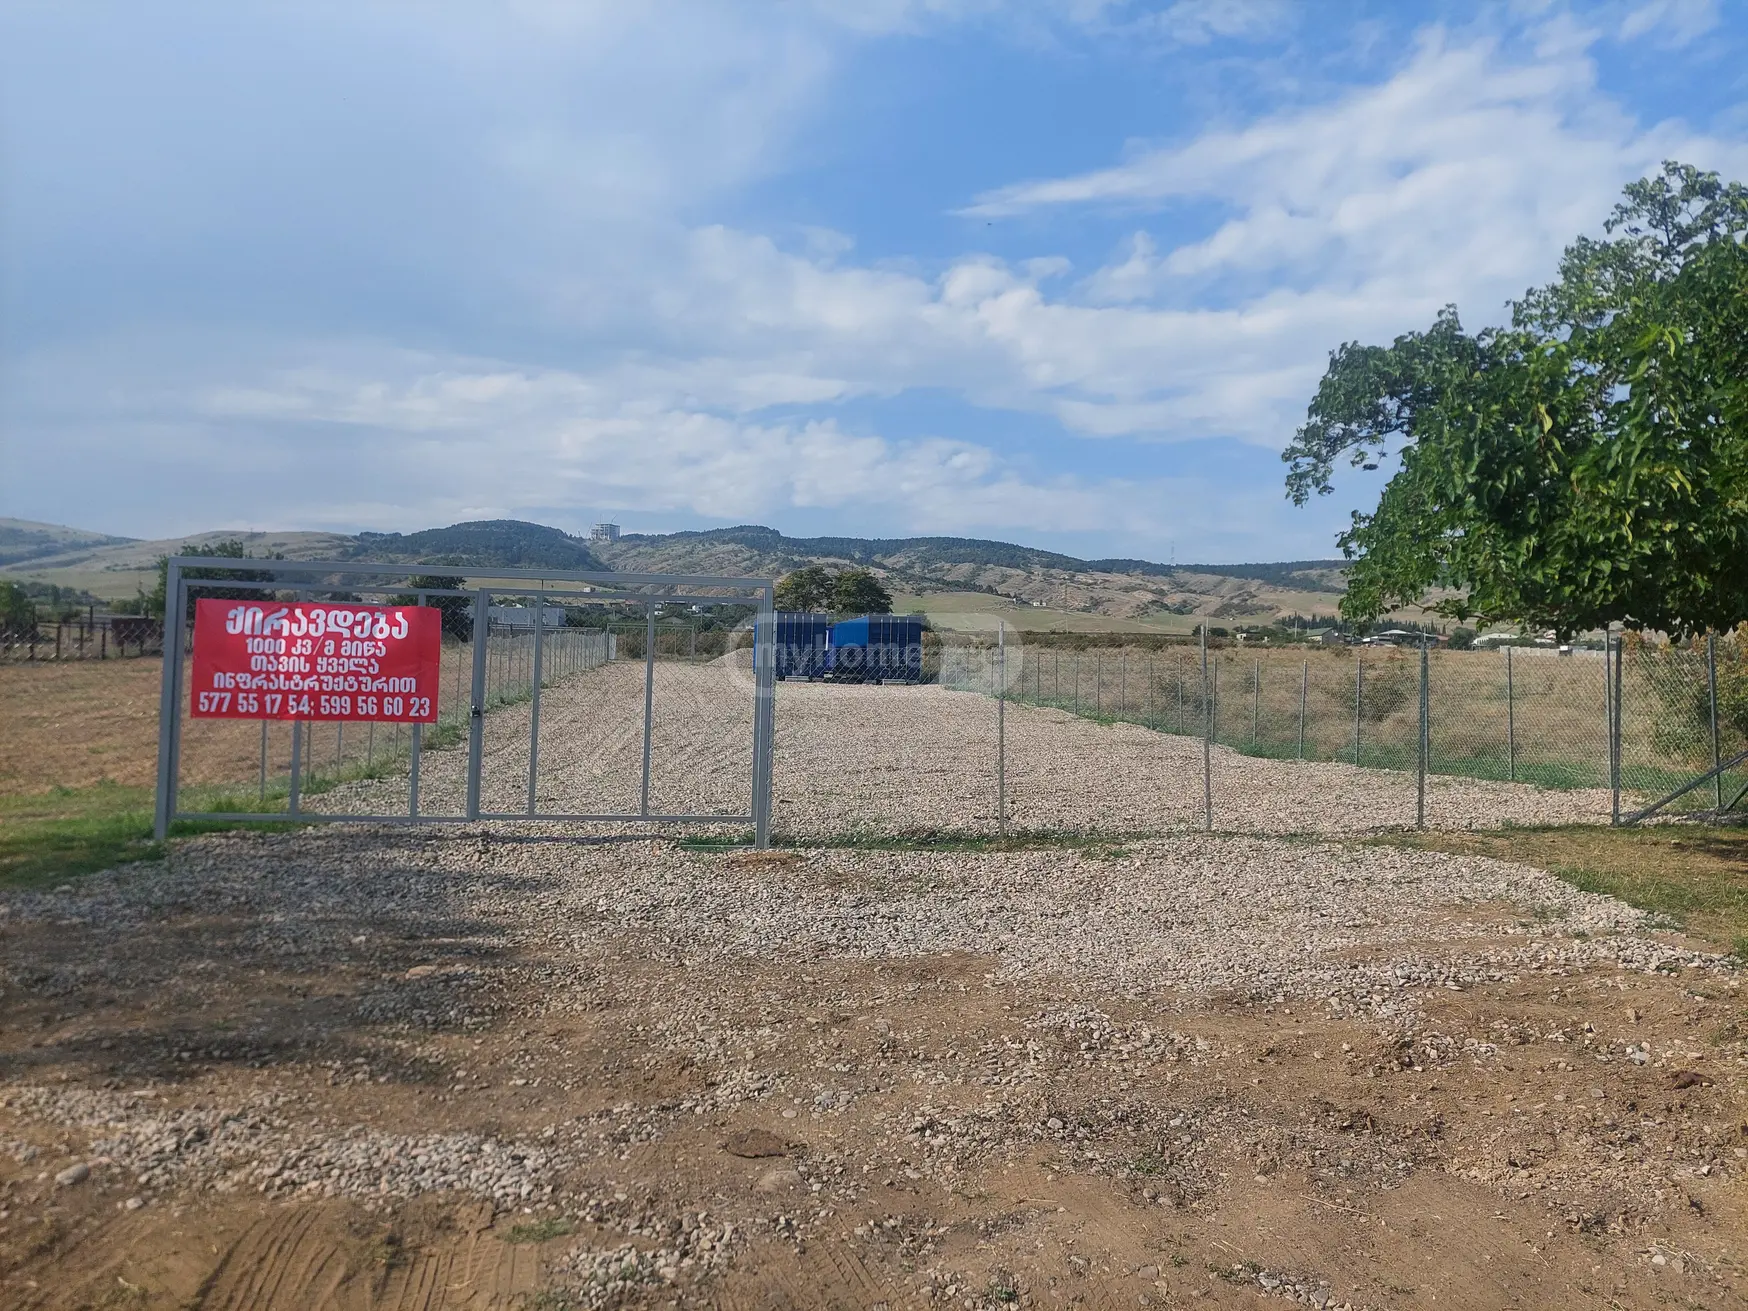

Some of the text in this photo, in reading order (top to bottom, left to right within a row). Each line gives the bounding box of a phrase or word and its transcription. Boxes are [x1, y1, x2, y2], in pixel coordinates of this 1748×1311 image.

[227, 606, 409, 640] ქირავდება
[246, 637, 287, 655] 1000
[340, 640, 387, 657] მიწა
[251, 655, 379, 674] თავის ყველა
[213, 672, 417, 693] ინფრასტრუქტურით
[199, 692, 430, 717] 577 55 17 54; 599 56 60 23
